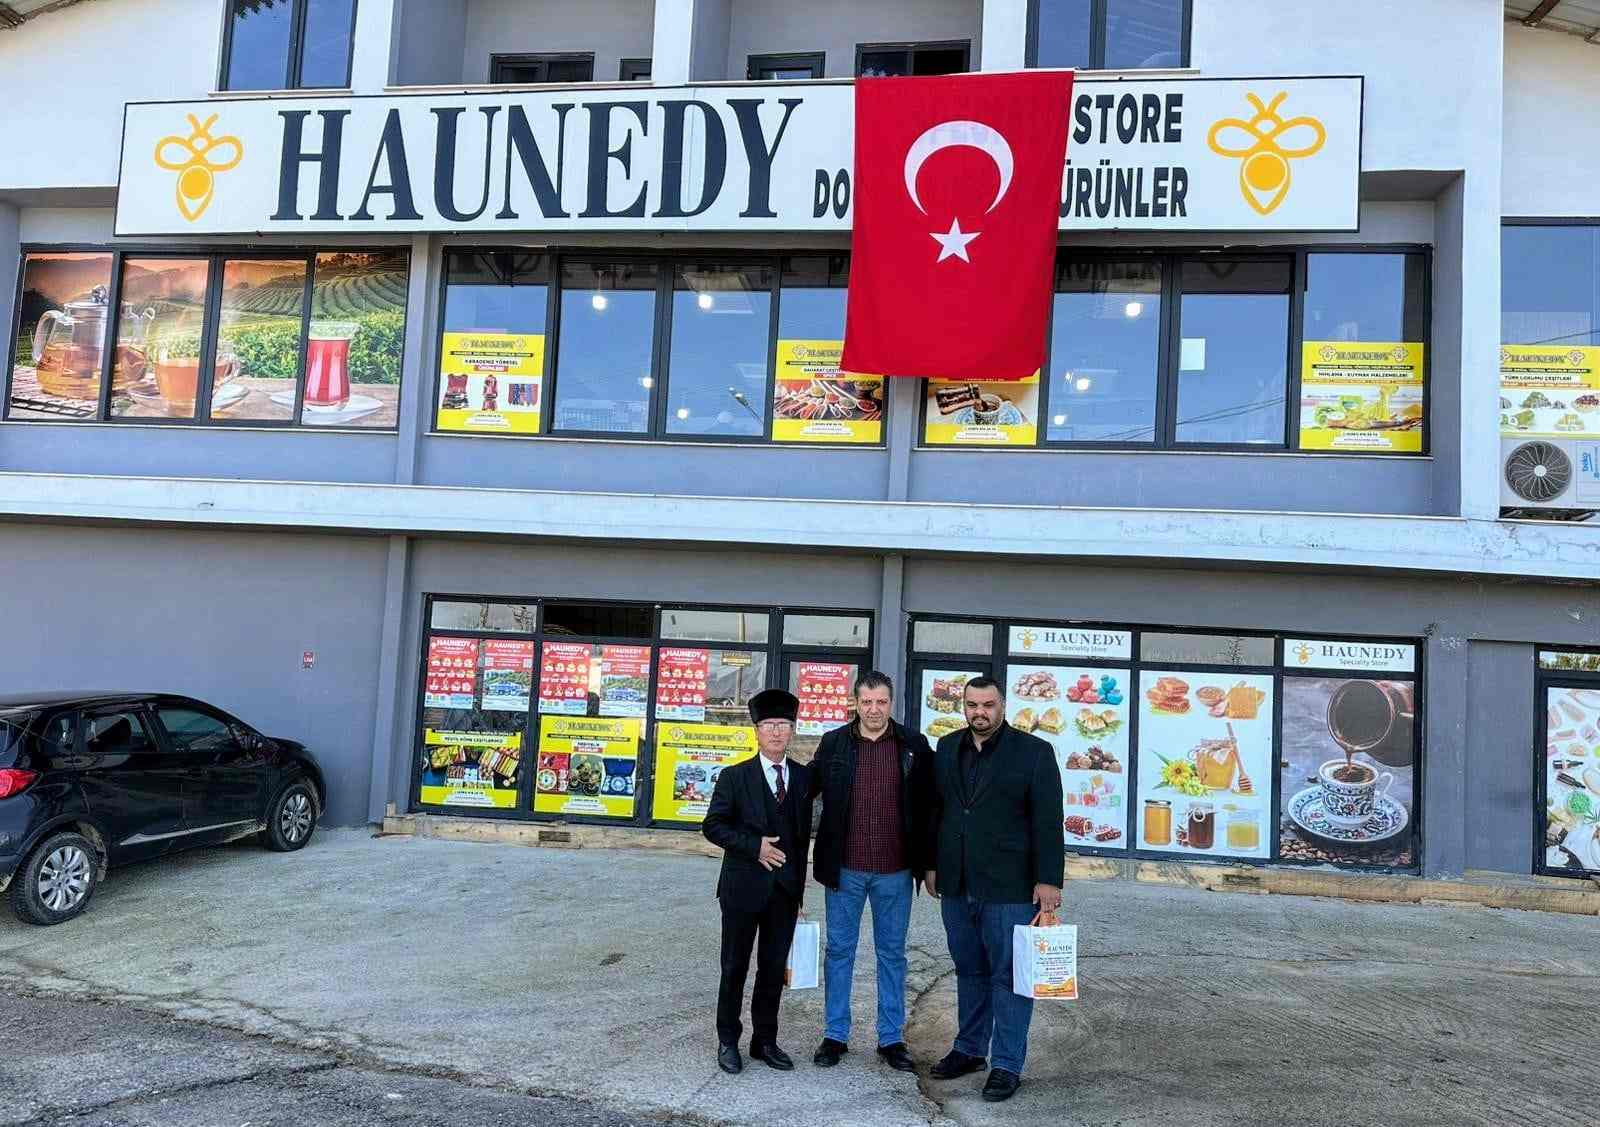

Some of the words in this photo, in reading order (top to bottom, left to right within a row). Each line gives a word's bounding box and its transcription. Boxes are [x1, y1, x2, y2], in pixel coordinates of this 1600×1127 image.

[1074, 93, 1184, 145] STORE
[270, 98, 803, 222] HAUNEDY
[813, 168, 851, 220] DO
[1045, 632, 1125, 646] HAUNEDY
[1321, 645, 1407, 659] HAUNEDY
[806, 664, 842, 672] HAUNEDY
[1339, 658, 1370, 667] Speciality
